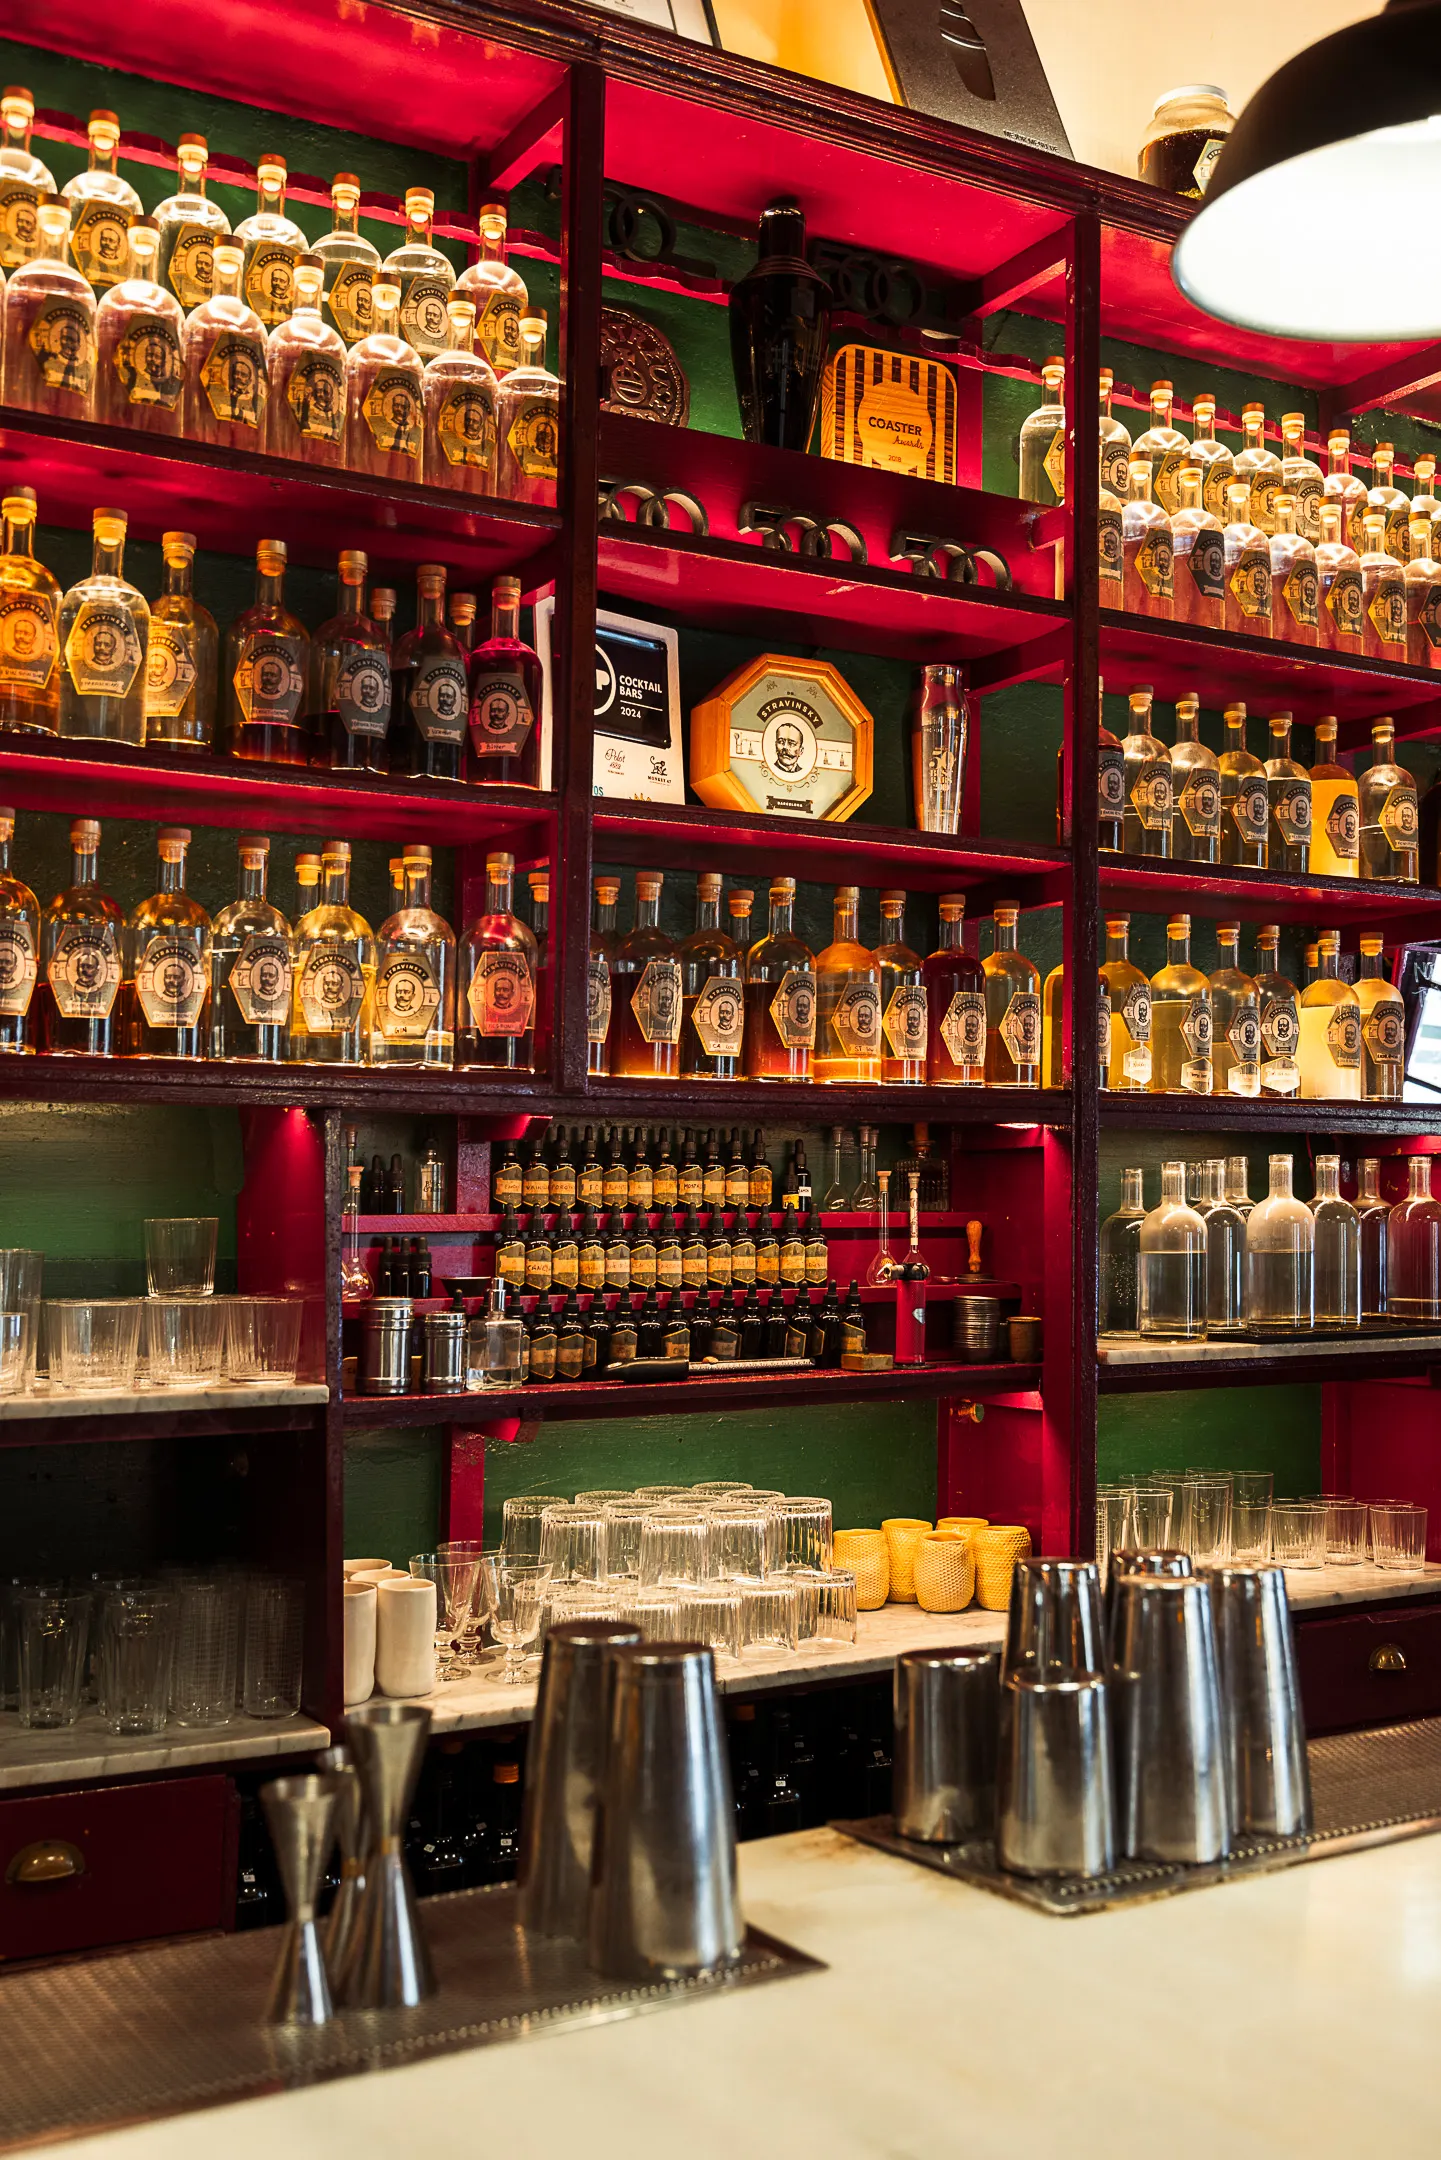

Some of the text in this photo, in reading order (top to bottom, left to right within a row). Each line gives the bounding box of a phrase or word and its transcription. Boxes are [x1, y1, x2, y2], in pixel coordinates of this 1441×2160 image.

[868, 416, 922, 437] COASTER
[892, 435, 924, 450] Awards
[1, 602, 49, 622] STRAVINSKY
[83, 614, 129, 633] STRAVINSKY
[427, 669, 463, 684] STRAVINSKY
[619, 674, 663, 694] COCKTAIL
[480, 684, 521, 698] STRAVINSKY
[619, 685, 643, 700] BARS
[620, 706, 641, 719] 2024
[761, 700, 820, 723] STRAVINSKY
[647, 775, 666, 783] MONKEY
[152, 948, 196, 963] STRAVINSKY
[313, 956, 354, 970] STRAVINSKY
[386, 965, 427, 978] STRAVINSKY
